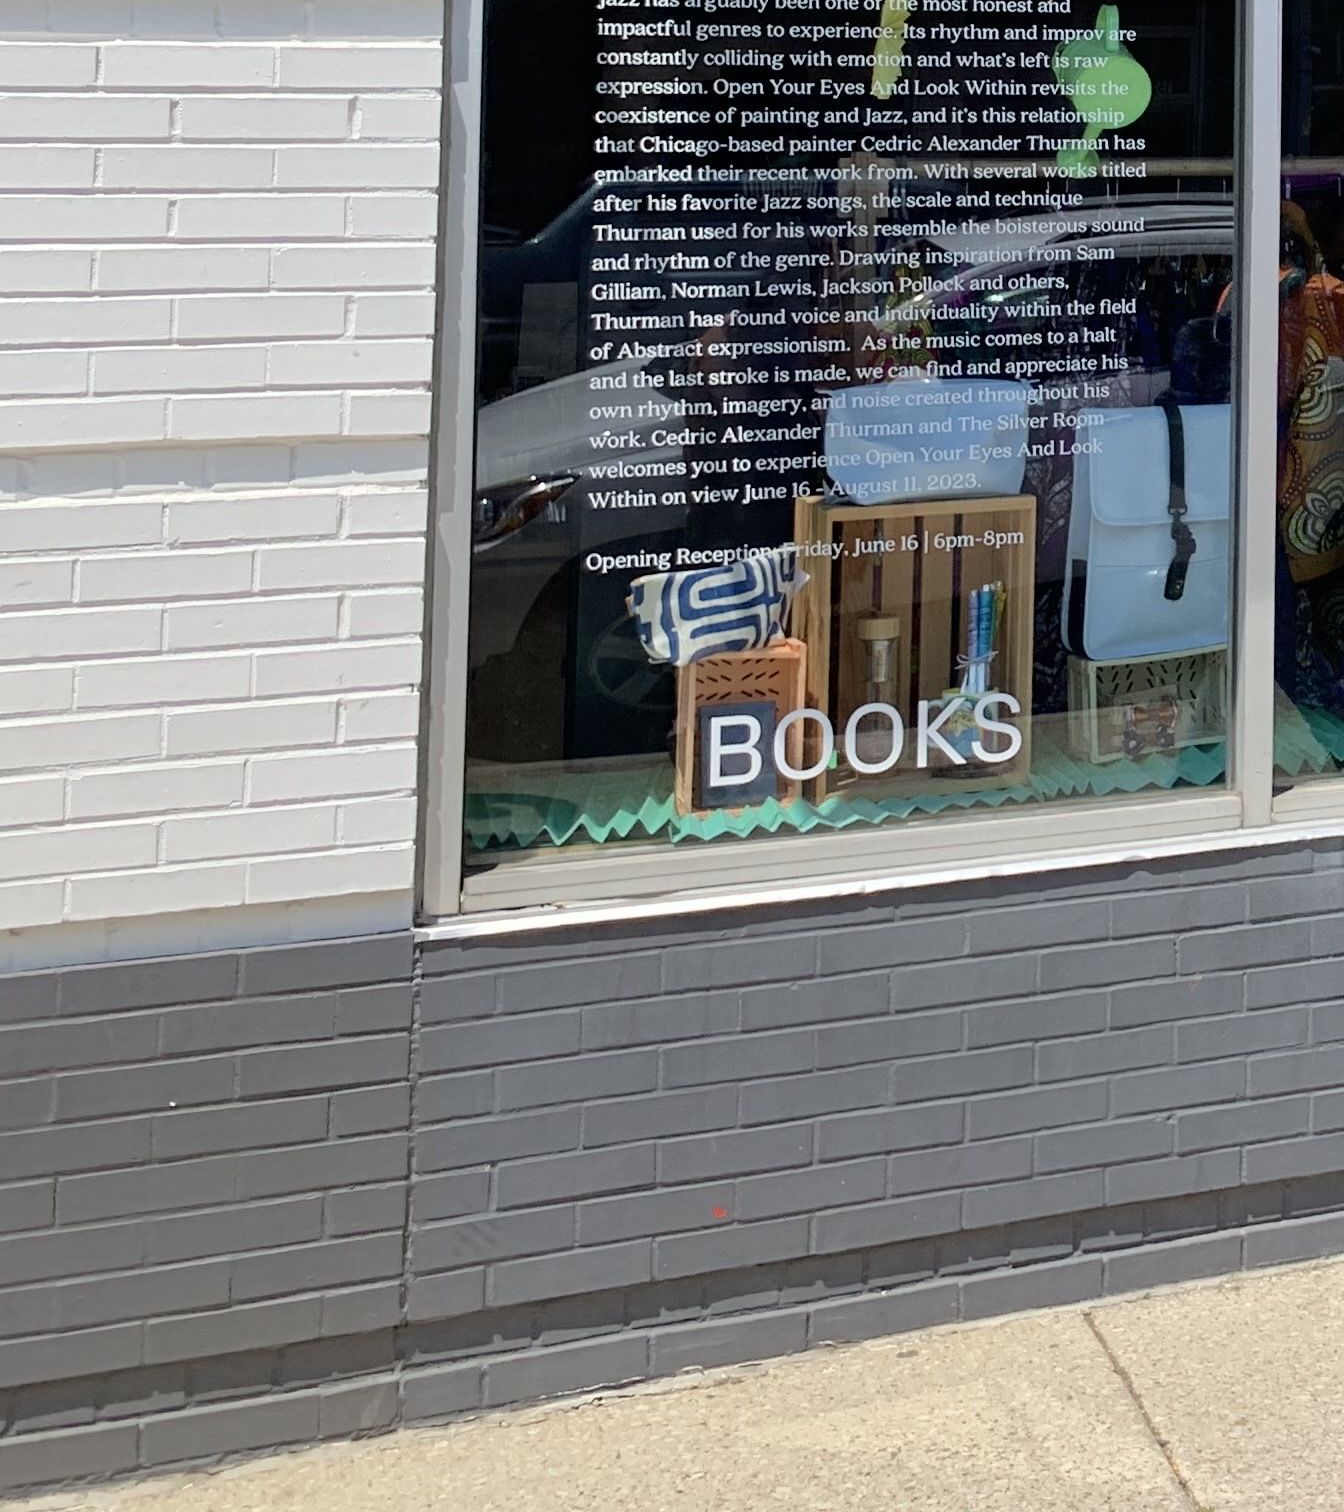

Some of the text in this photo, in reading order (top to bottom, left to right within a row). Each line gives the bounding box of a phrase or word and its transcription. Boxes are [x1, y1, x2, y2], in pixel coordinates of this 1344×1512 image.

[597, 19, 1137, 45] impactful genres to experience. Its rhythm and improv are
[596, 48, 1110, 71] constantly colliding with emotion and what's left is raw
[595, 77, 1129, 100] expression. Open Your Eyes And Look Within revisits the
[594, 106, 1125, 129] coexistence of painting and Jazz, and it's this relationship
[593, 133, 1146, 157] that Chicago-based painter Cedric Alexander Thurman has
[593, 160, 1147, 182] embarked their recent work from. With several works titled
[592, 188, 1083, 213] after his favorite Jazz songs, the scale and technique
[591, 215, 1145, 241] Thurman used for his works resemble the boisterous sound
[590, 244, 1116, 274] and rhythm of the genre. Drawing inspiration from Sam
[584, 547, 673, 572] Opening
[852, 535, 896, 556] June
[900, 534, 919, 553] 16
[933, 529, 1025, 553] 6pm-8pm
[708, 692, 1023, 788] BOOKS
